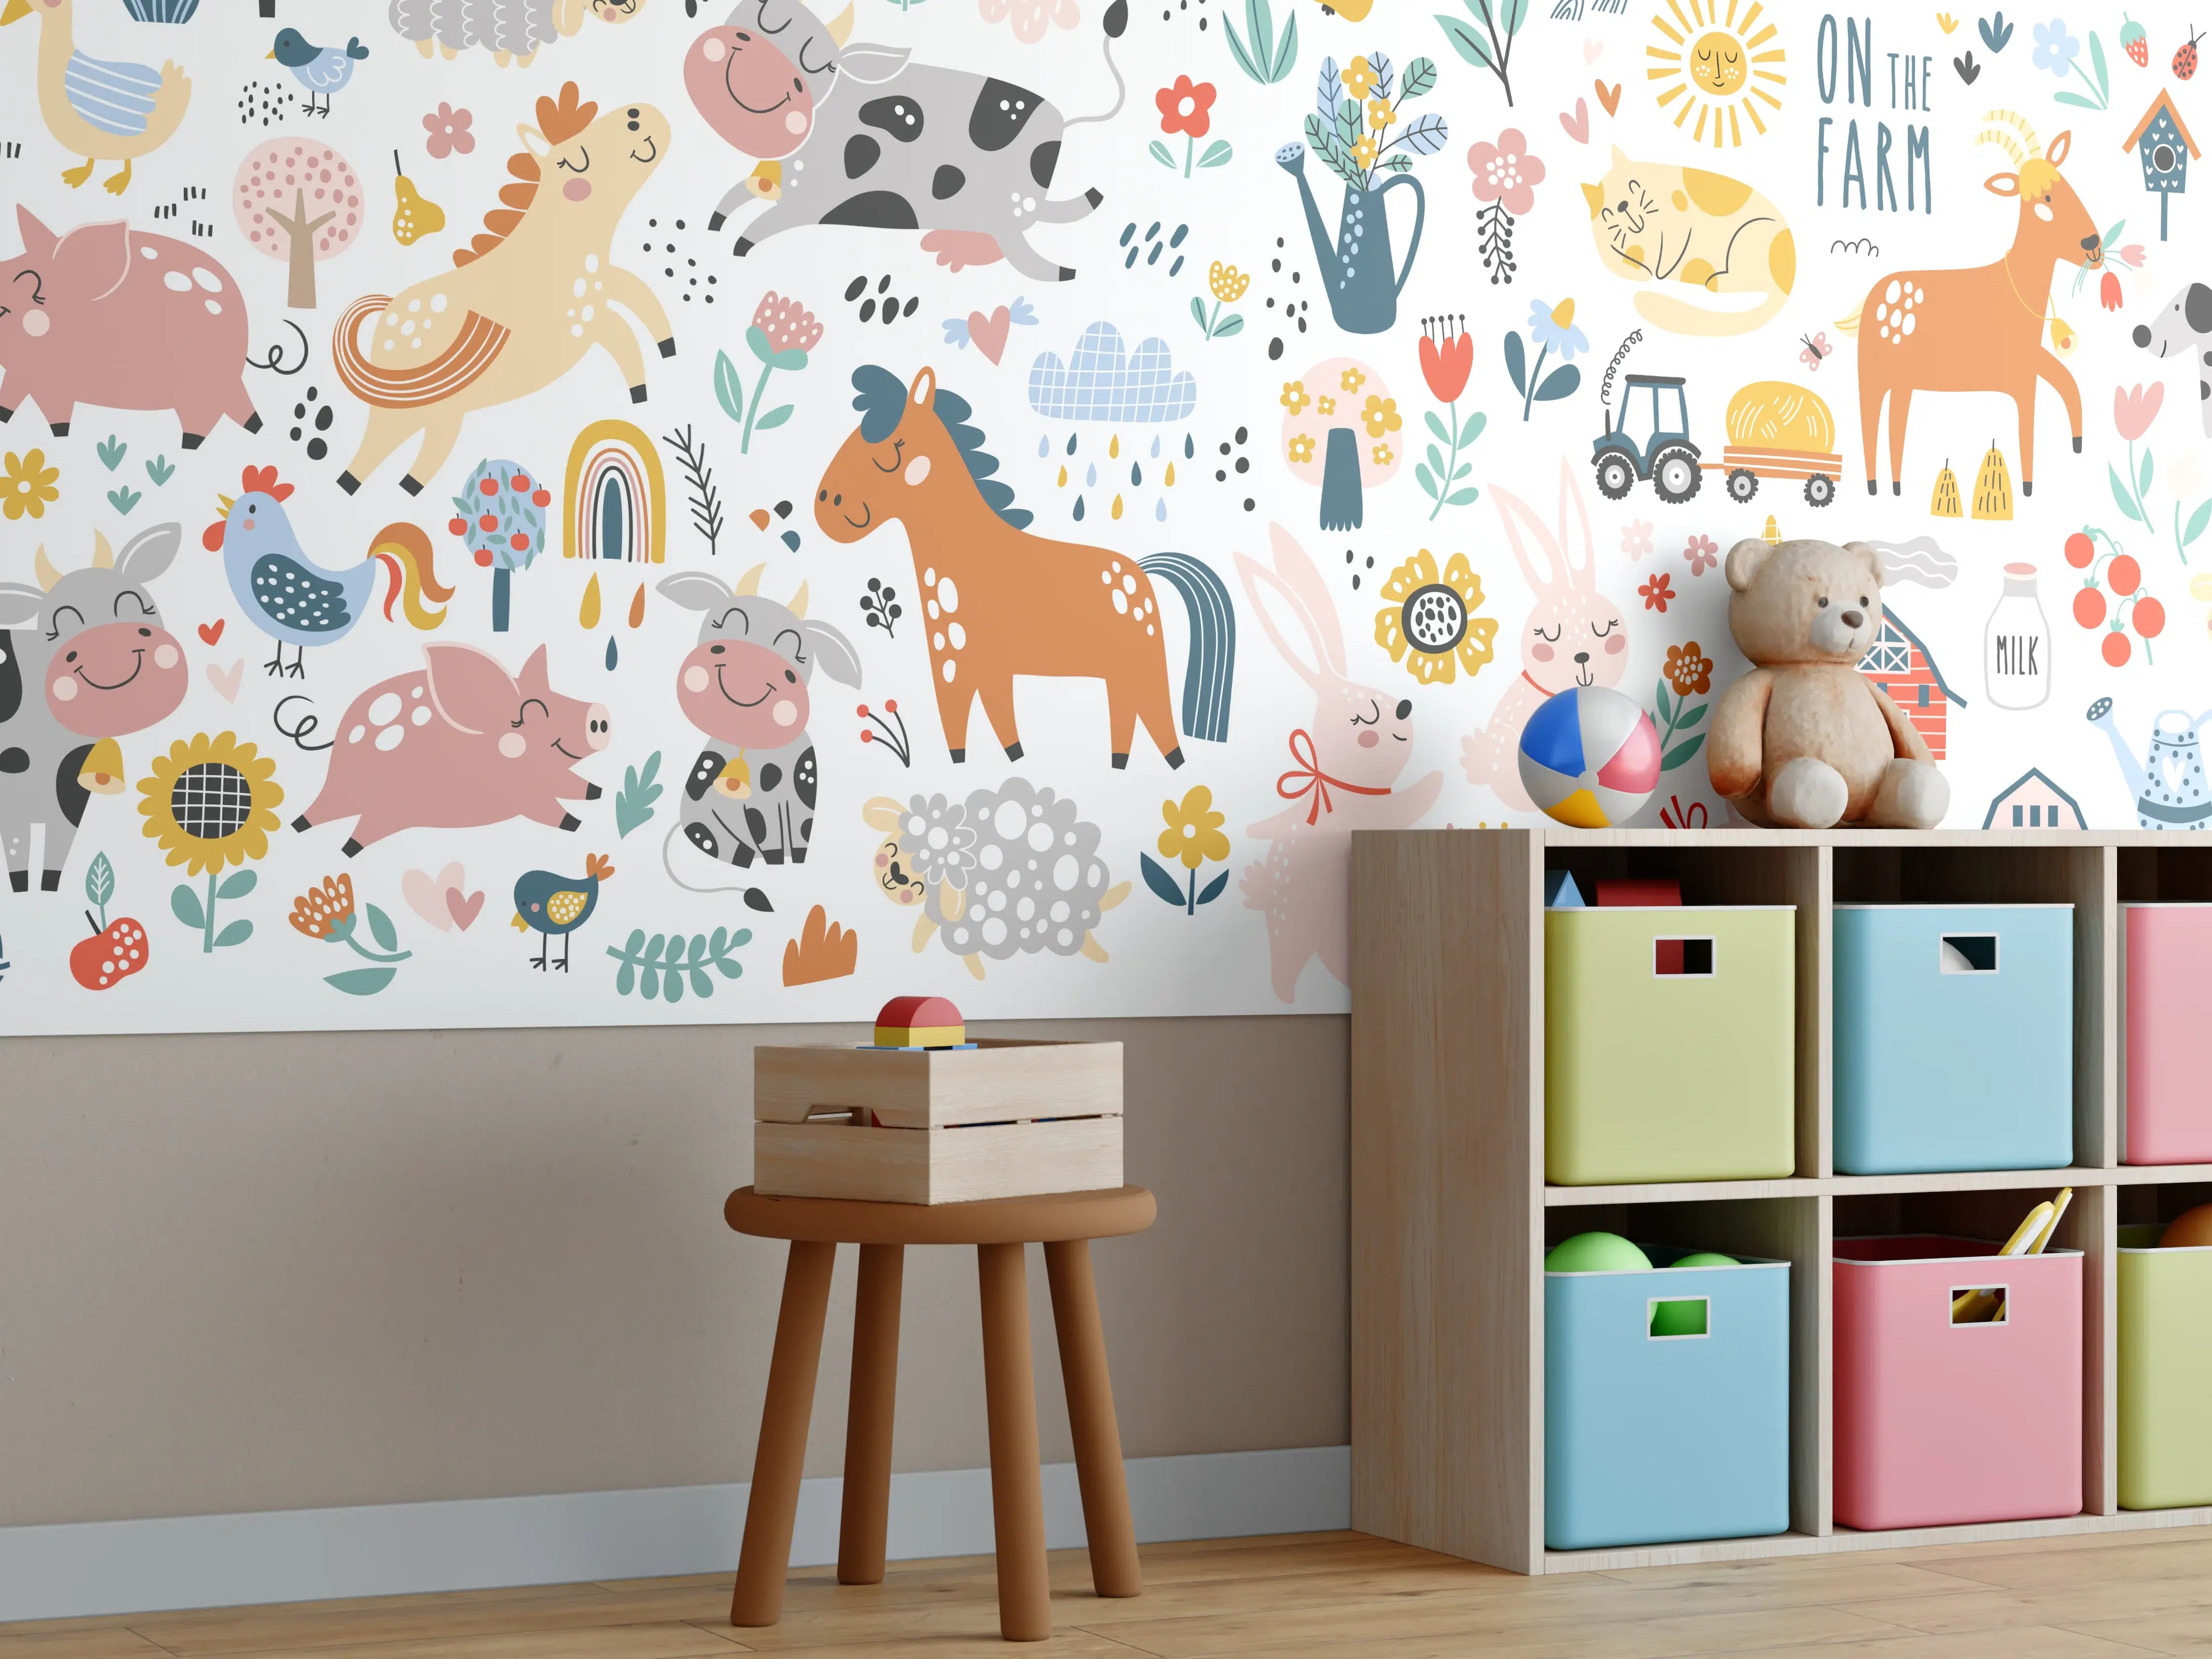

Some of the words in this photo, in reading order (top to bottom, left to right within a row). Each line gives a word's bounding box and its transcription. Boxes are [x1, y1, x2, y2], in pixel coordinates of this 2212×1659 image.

[1817, 14, 1871, 107] ON
[1887, 53, 1933, 112] THE
[1817, 117, 1932, 215] FARM
[1997, 635, 2038, 676] MILK
